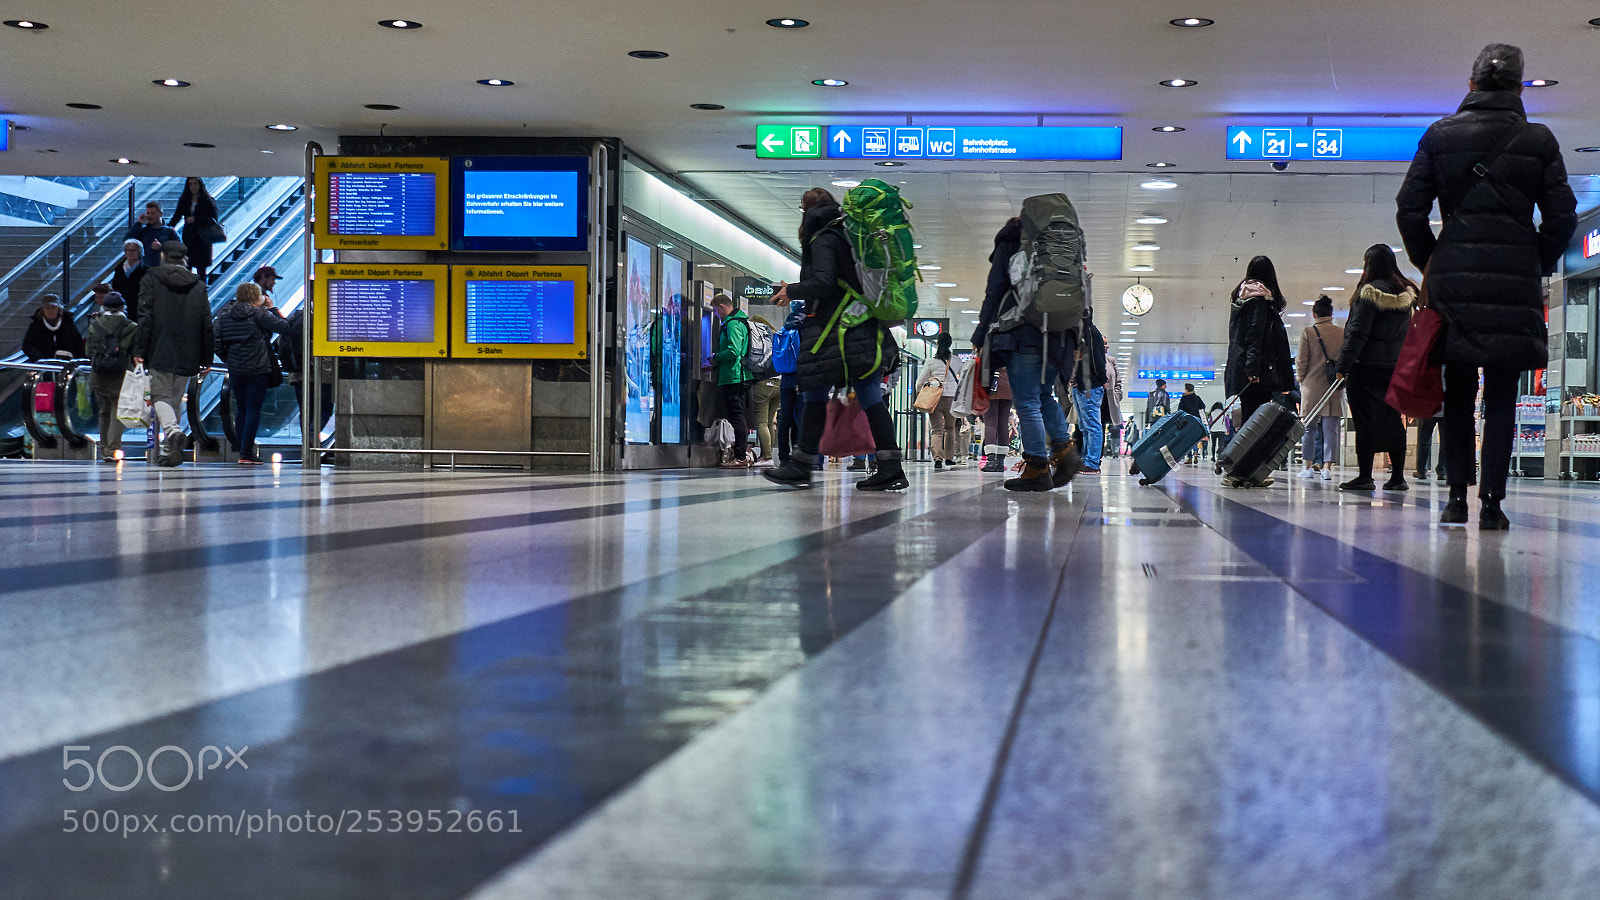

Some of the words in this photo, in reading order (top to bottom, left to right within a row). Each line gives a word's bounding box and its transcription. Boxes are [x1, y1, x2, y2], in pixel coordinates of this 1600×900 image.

[930, 141, 953, 153] WC
[963, 139, 1008, 147] Bahnhofplatz
[1267, 139, 1285, 153] 21
[1317, 140, 1338, 154] 34
[963, 146, 1017, 154] Bahnhofstrasse
[368, 162, 391, 170] Départ
[339, 268, 365, 276] Abfahrt
[367, 268, 390, 277] Départ
[506, 270, 529, 278] Départ
